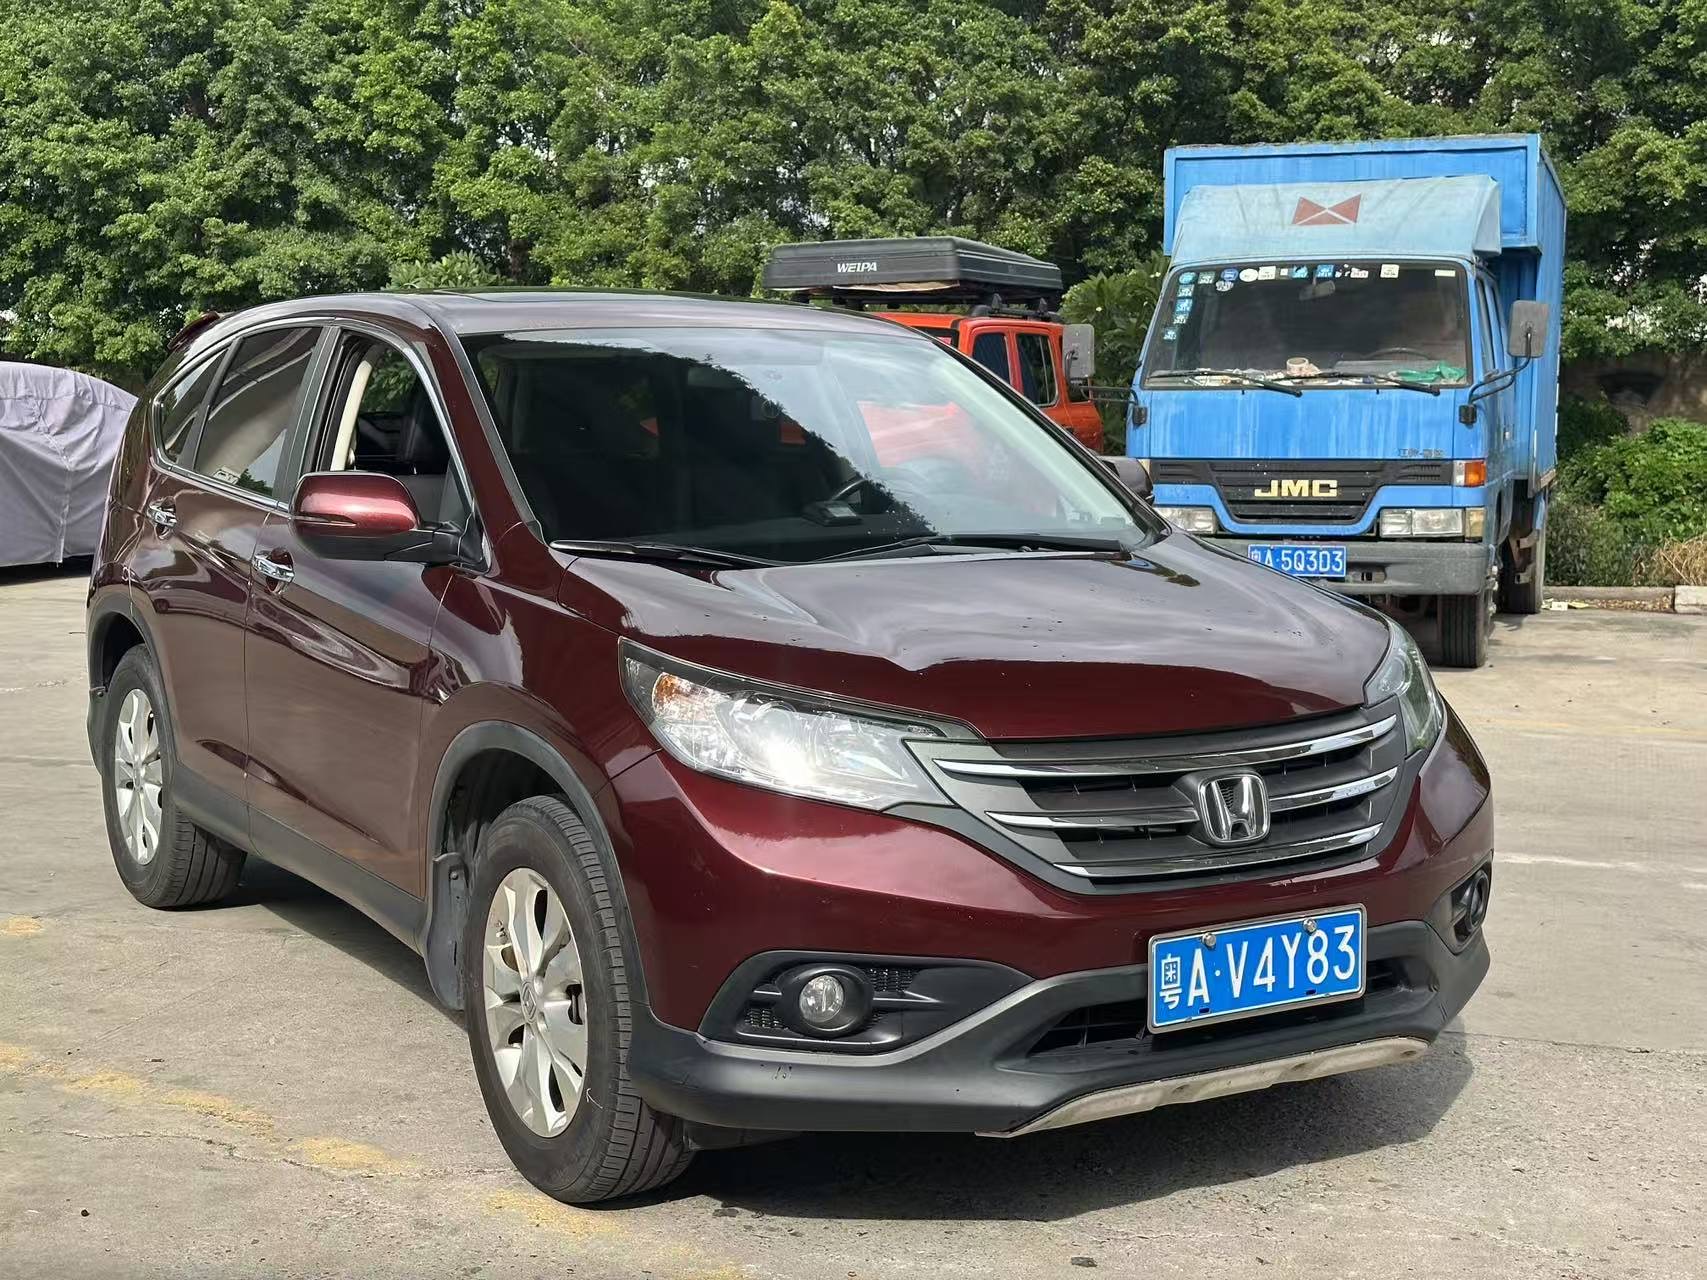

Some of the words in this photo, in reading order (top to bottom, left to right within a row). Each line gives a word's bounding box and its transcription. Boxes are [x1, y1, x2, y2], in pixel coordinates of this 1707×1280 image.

[837, 262, 877, 273] WEIPA
[1254, 479, 1338, 497] JMC
[1159, 924, 1355, 1010] 粤A·V4Y83
